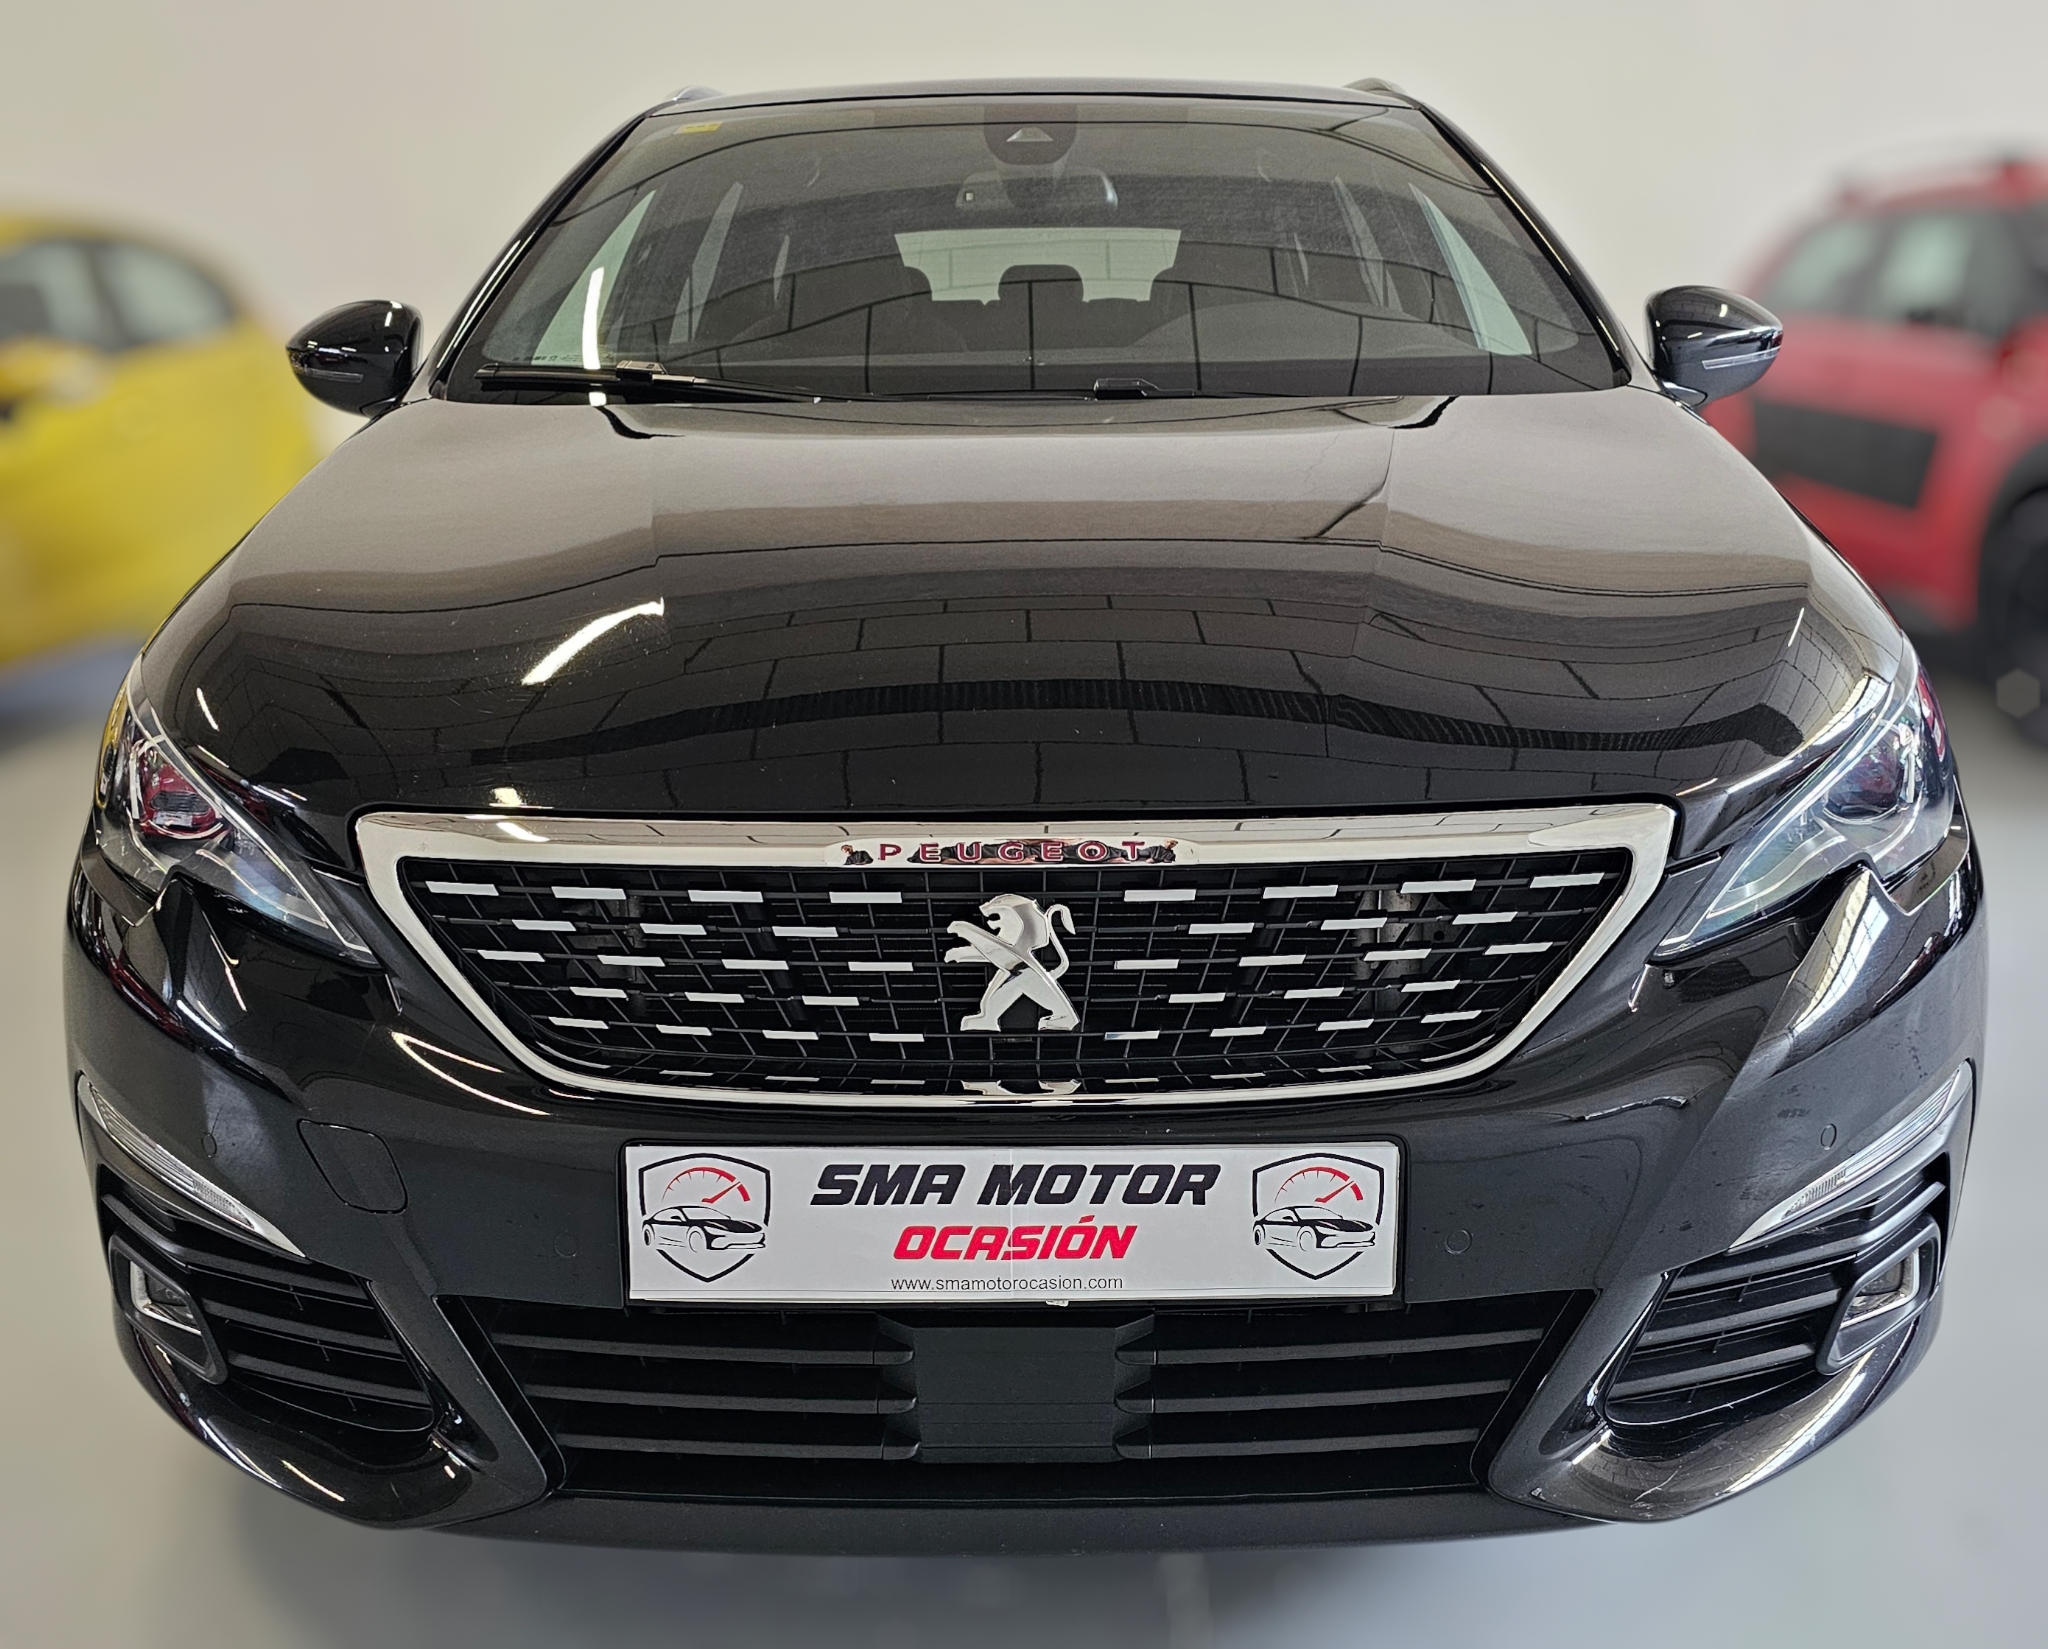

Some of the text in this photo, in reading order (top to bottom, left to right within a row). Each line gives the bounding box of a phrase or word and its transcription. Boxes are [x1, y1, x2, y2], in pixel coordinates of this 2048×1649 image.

[879, 840, 1146, 862] PEUGEOT
[810, 1164, 1221, 1205] SMA MOTOR
[893, 1215, 1138, 1260] OCASIÓN
[890, 1275, 1123, 1291] www.smamotorocasion.com
